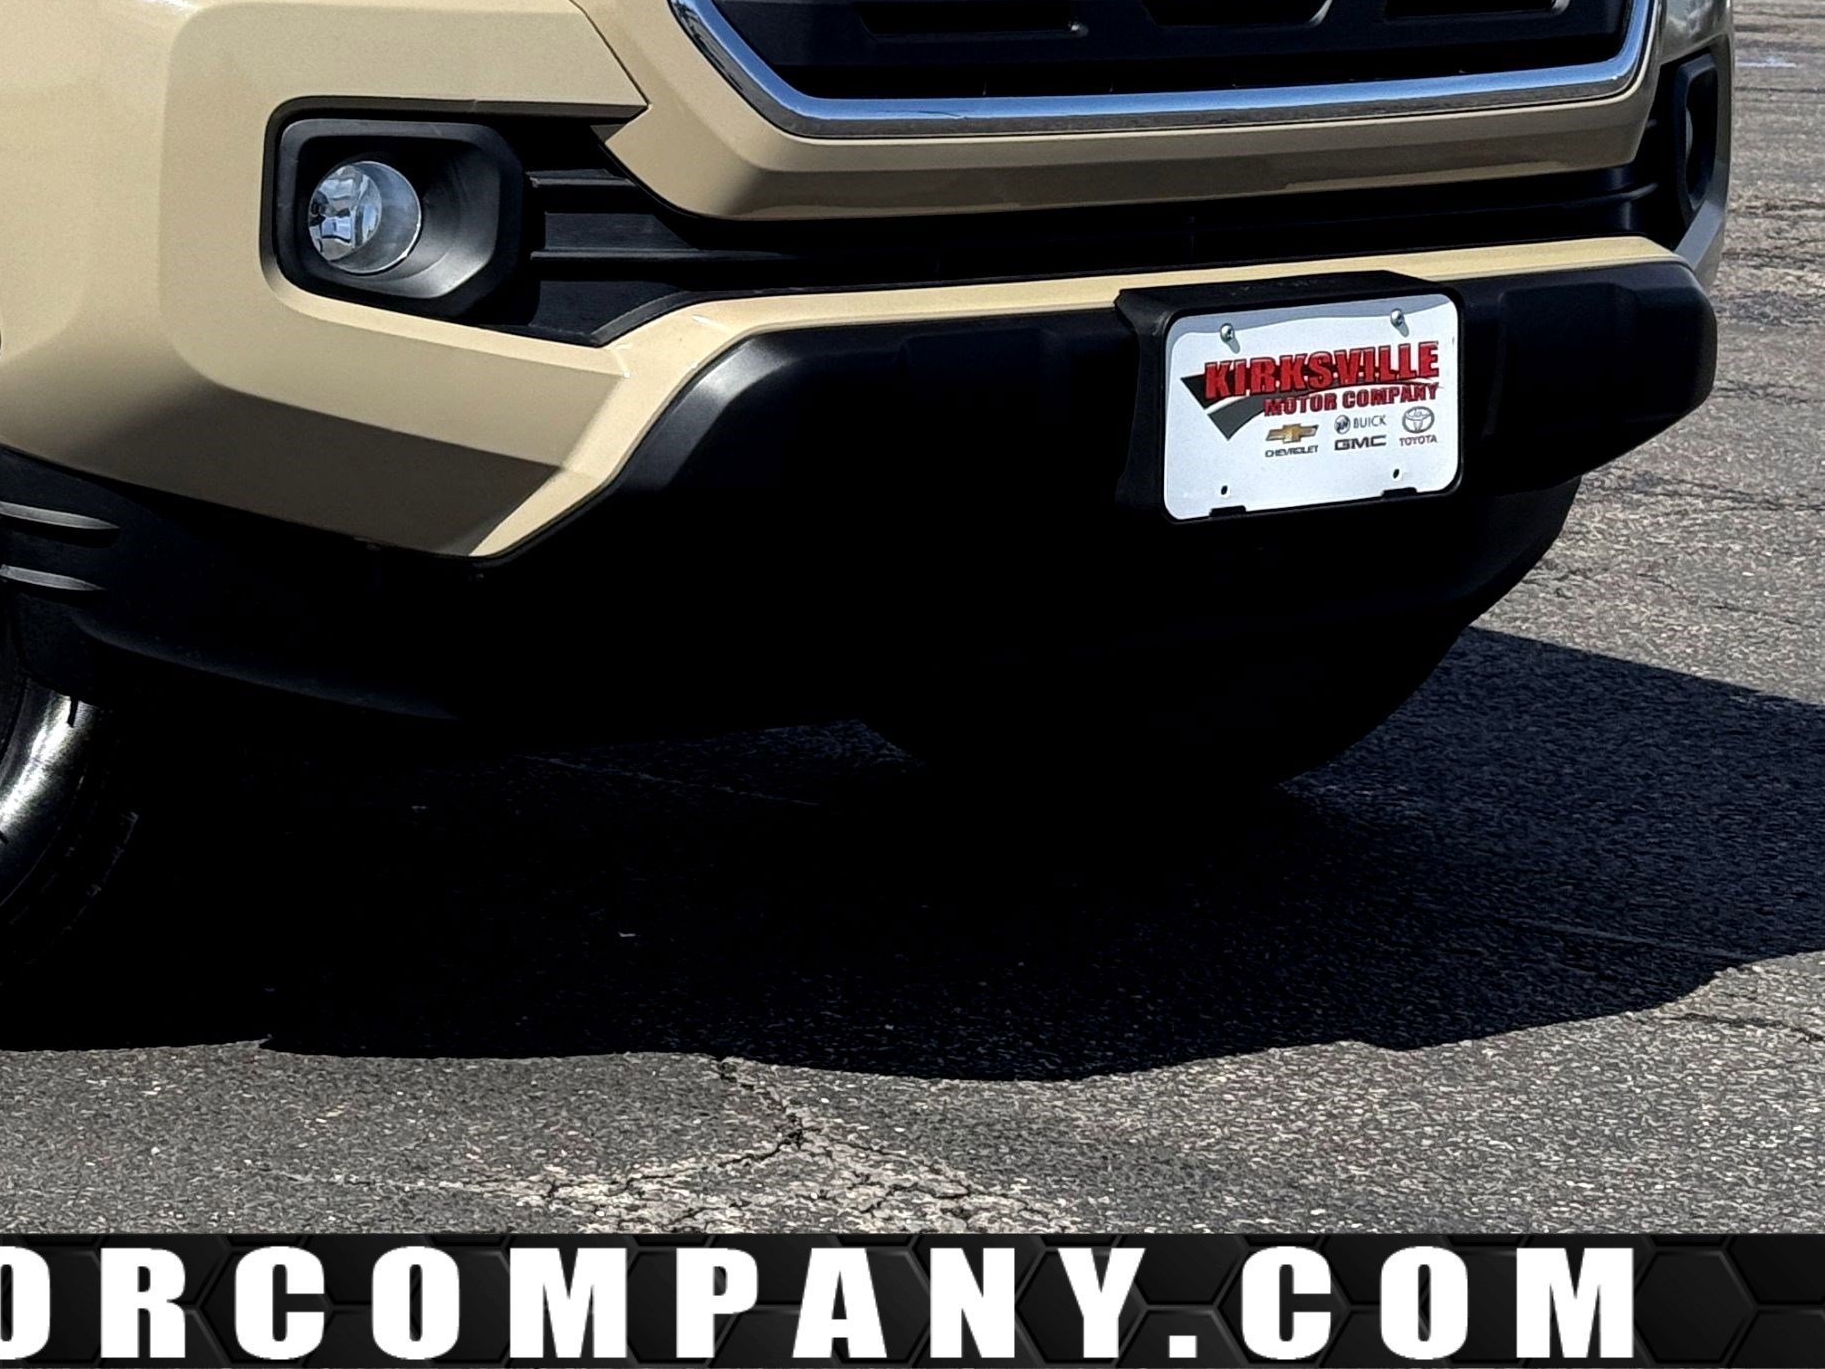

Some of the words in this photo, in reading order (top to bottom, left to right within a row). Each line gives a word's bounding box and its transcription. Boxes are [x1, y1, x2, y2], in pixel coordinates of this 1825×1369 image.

[1203, 340, 1441, 400] KIRKSVILLE
[1264, 392, 1338, 417] MOTOR
[1342, 382, 1440, 409] COMPANY
[1353, 415, 1387, 429] BUICK
[1334, 434, 1387, 451] GMC
[1399, 434, 1438, 447] TOYOTA
[1265, 445, 1319, 458] CHEVROLET
